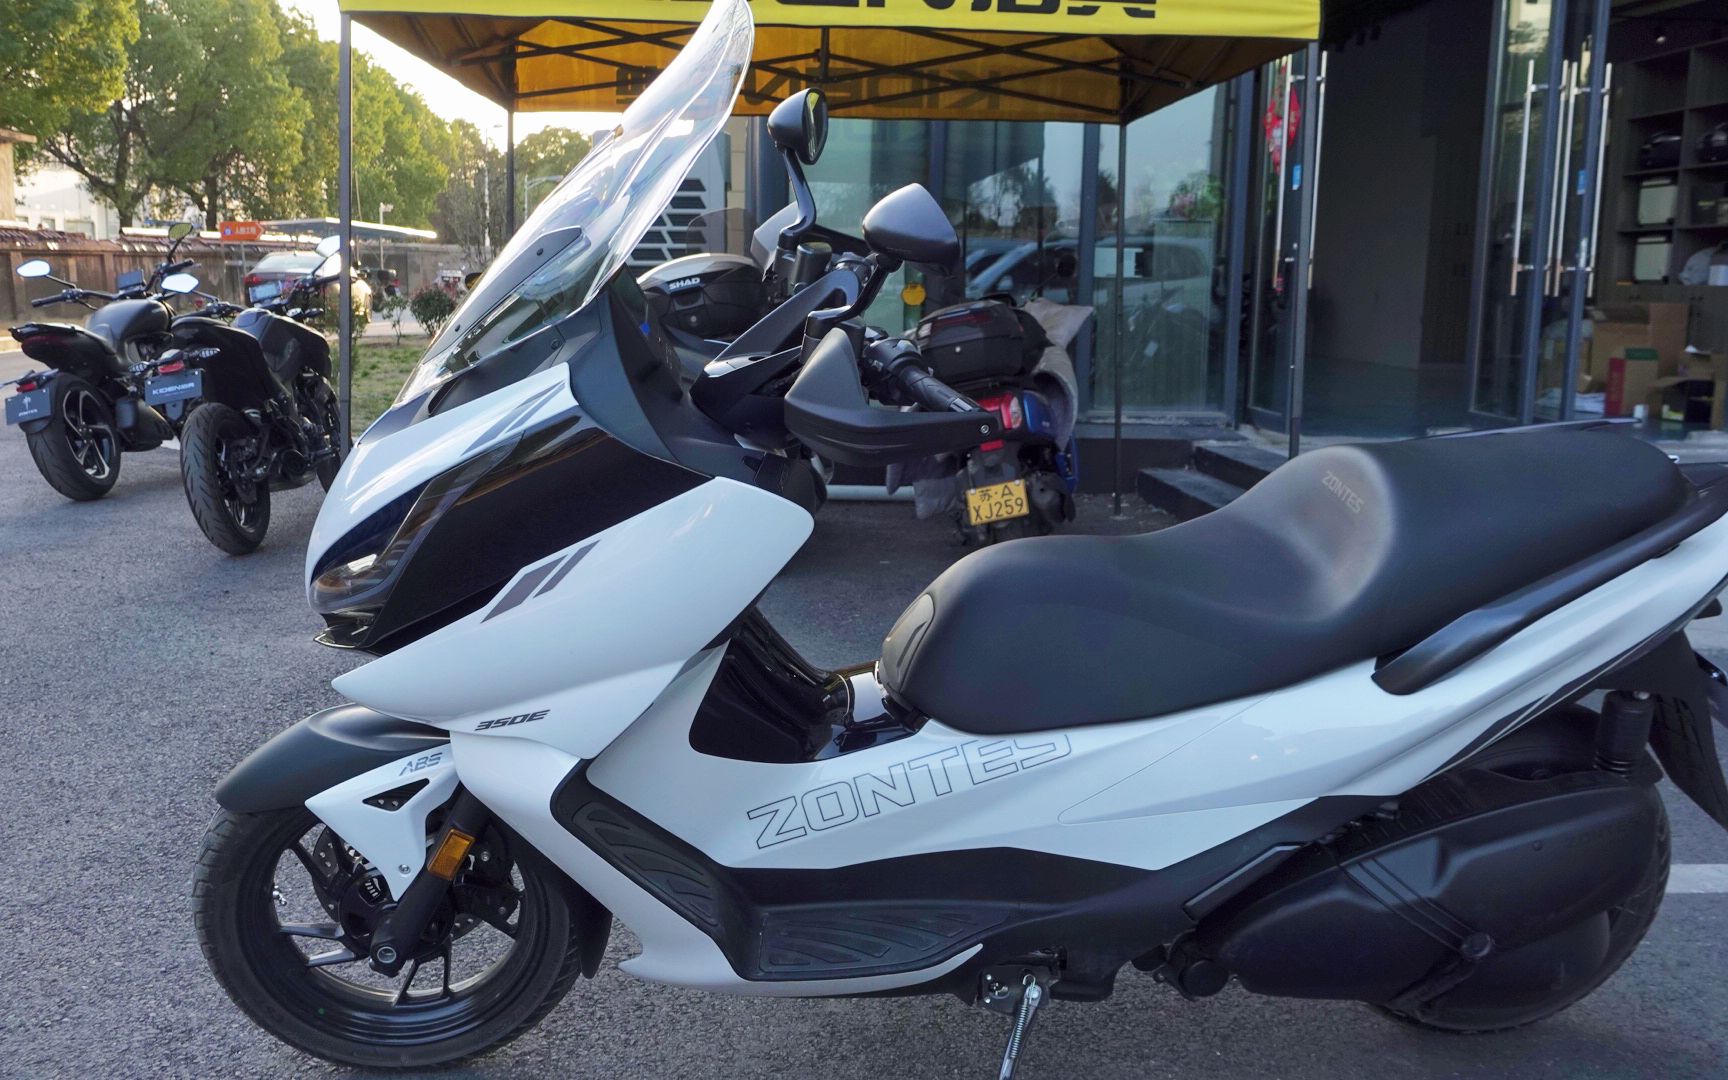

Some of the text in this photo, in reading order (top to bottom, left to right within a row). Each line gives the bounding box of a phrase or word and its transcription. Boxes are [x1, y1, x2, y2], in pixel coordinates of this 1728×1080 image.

[669, 277, 701, 290] SHAD
[1321, 470, 1365, 514] ZONTES
[972, 496, 1025, 522] XJ259
[474, 709, 551, 732] 350E
[398, 751, 443, 777] ABS
[746, 734, 1072, 850] ZONTES
